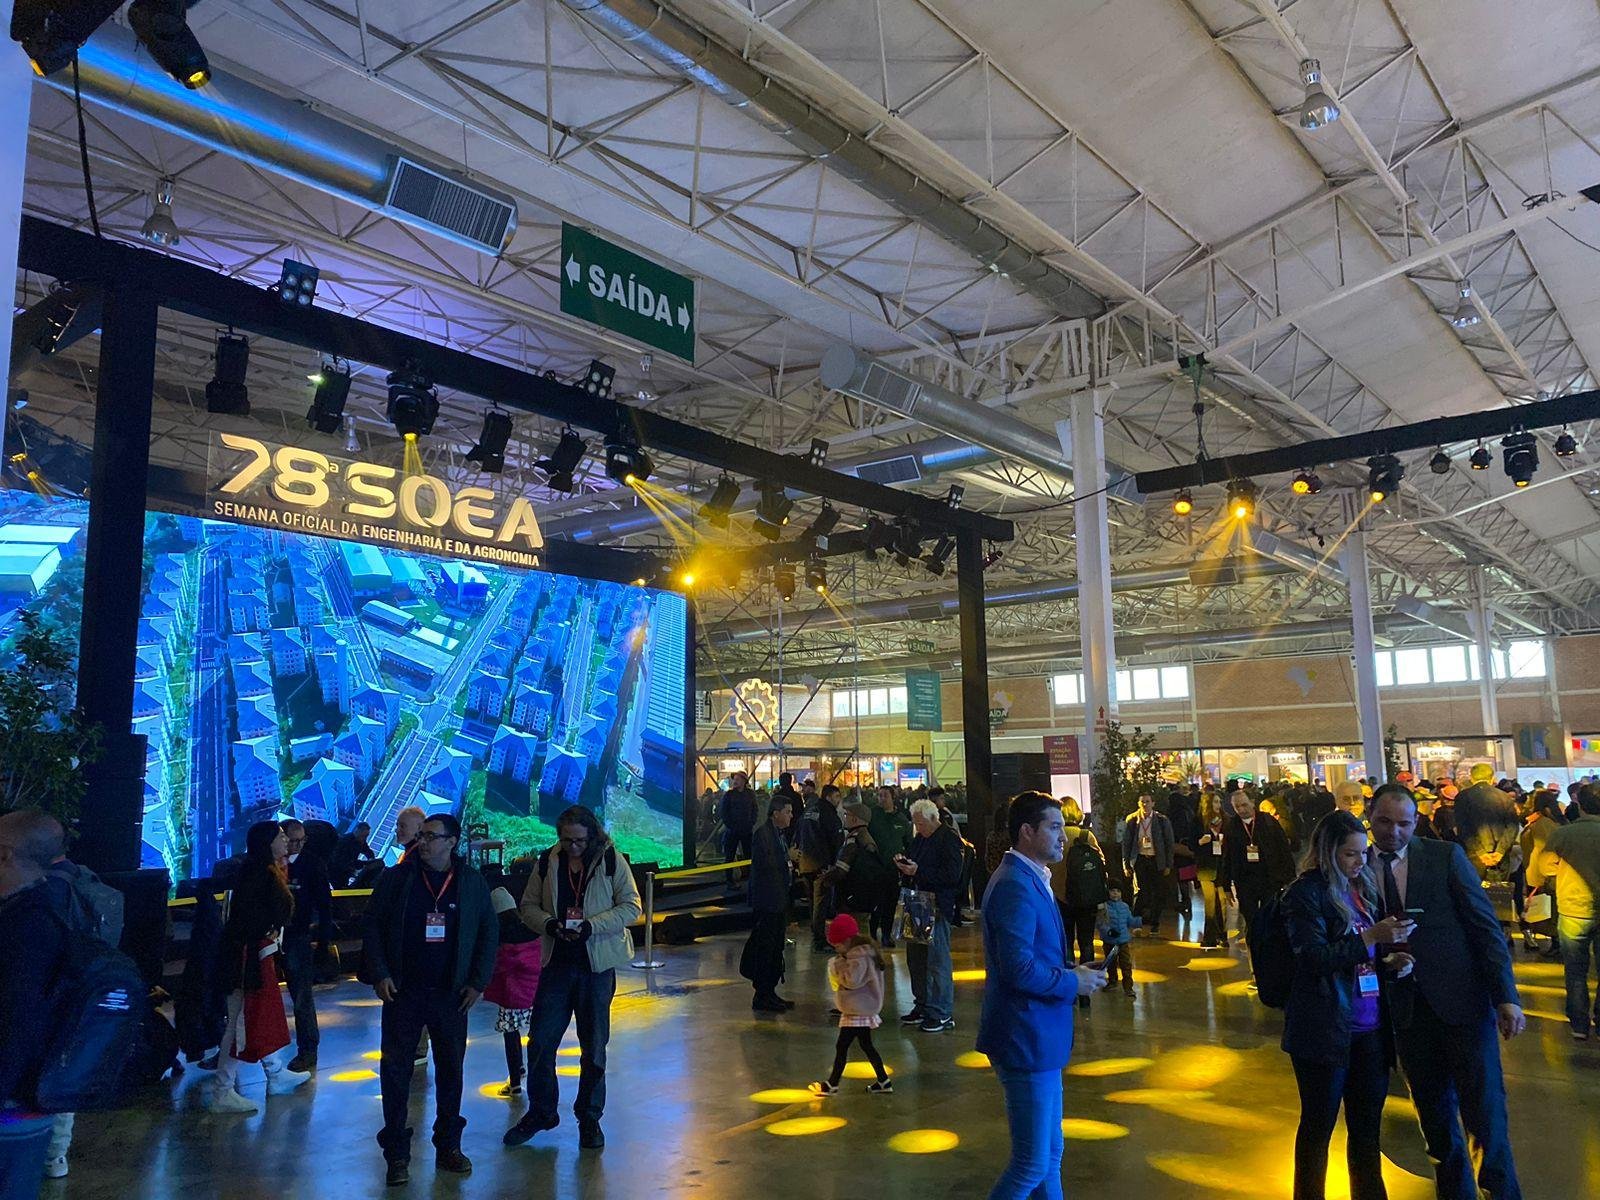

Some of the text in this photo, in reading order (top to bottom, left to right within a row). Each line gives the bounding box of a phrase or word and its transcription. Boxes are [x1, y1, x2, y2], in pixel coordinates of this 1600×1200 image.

[588, 264, 673, 327] SAÍDA
[214, 501, 540, 567] SEMANA OFICIAL DA ENGENHARIA E DA AGRONOMIA
[345, 462, 544, 549] SOEA
